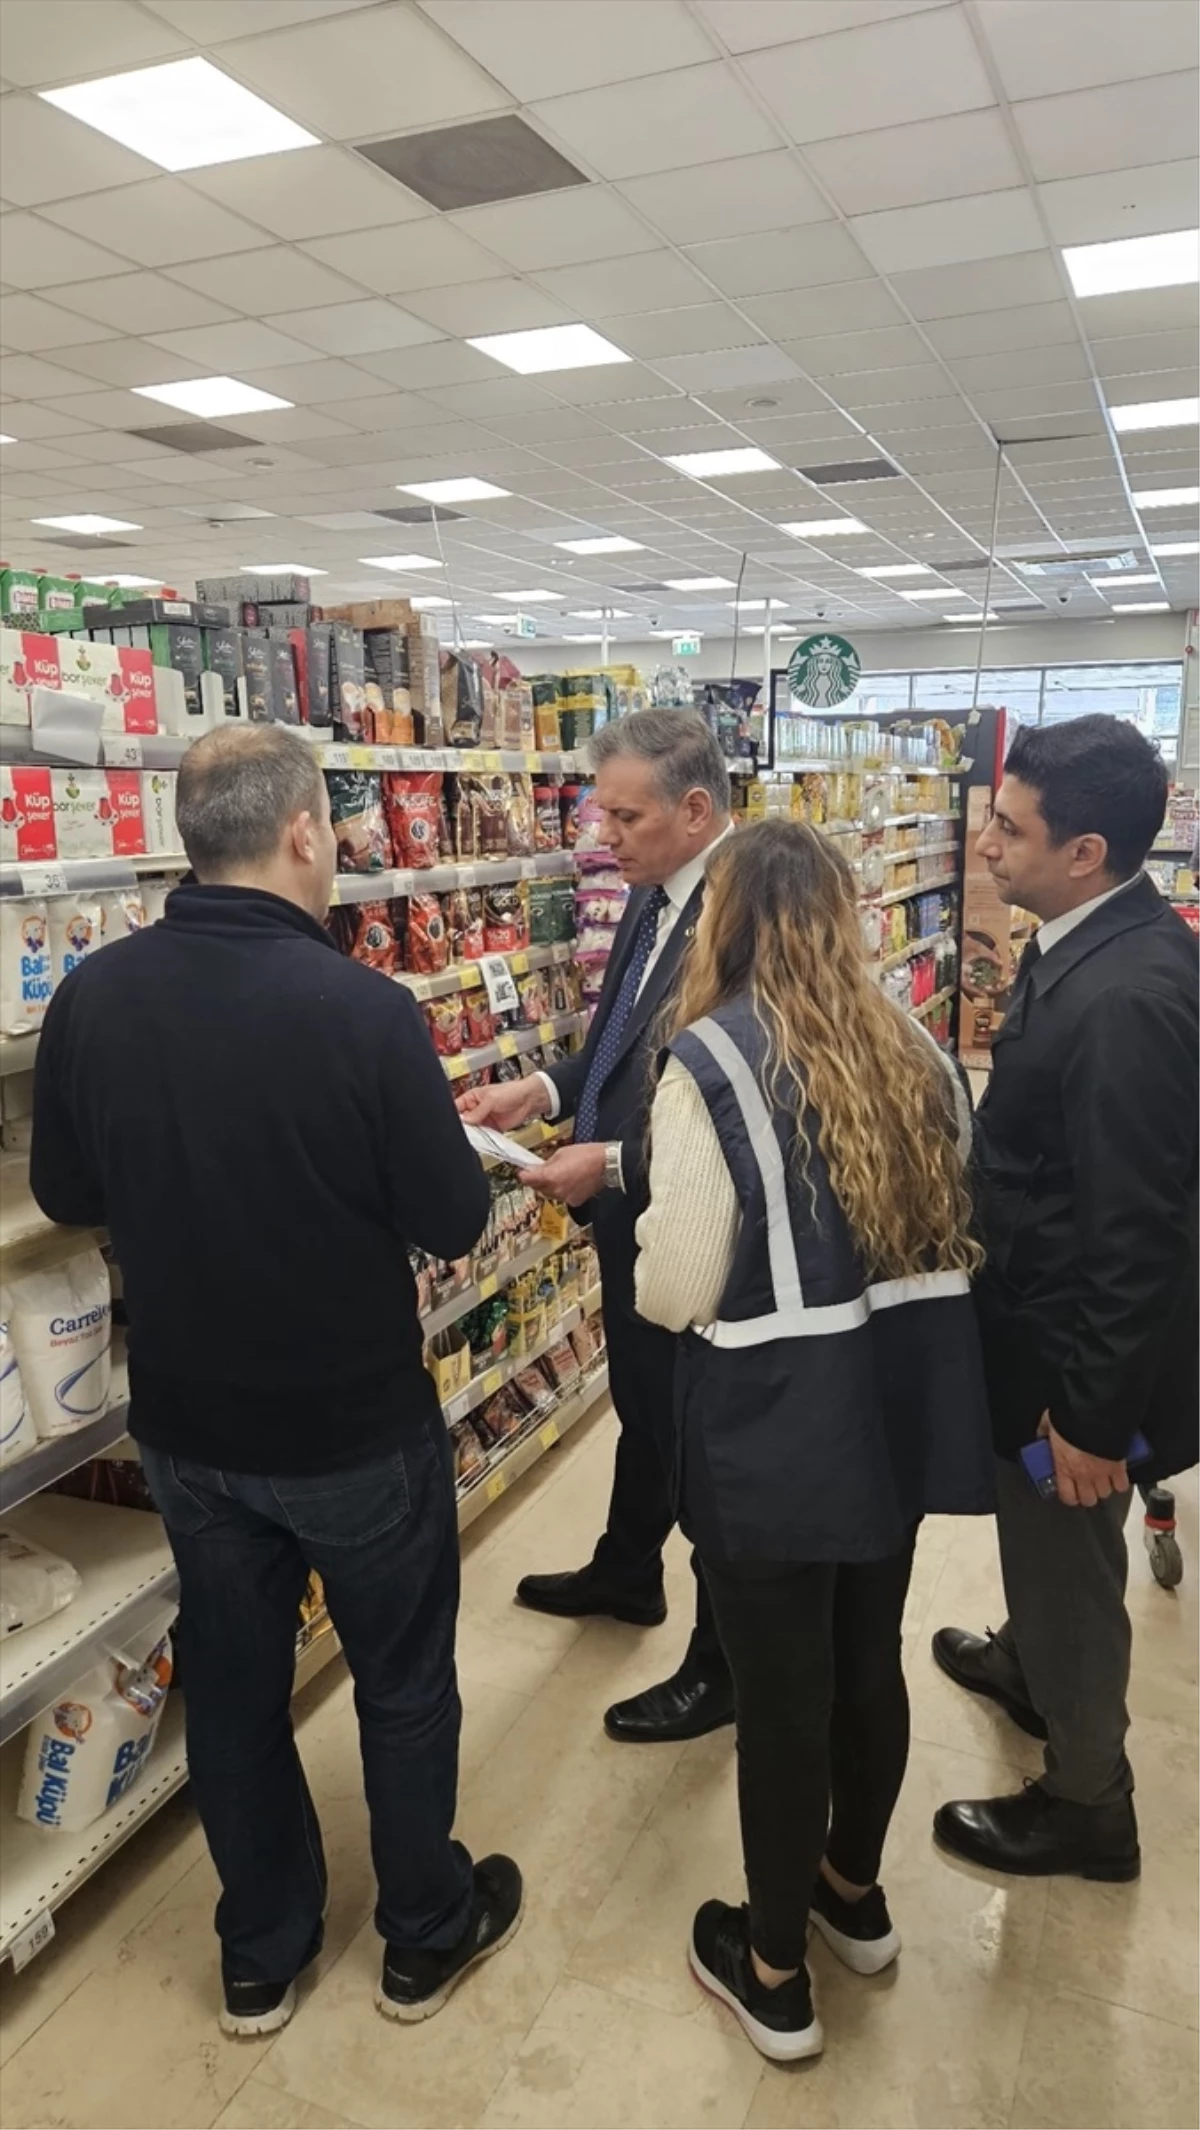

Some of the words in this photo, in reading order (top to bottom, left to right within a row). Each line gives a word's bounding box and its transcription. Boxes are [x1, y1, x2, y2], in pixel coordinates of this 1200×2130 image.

[33, 659, 58, 676] Küp
[129, 671, 152, 687] Küp
[24, 792, 50, 808] Küp
[118, 791, 140, 807] Küp
[21, 955, 43, 977] Bal
[47, 1739, 76, 1774] Bal
[35, 1772, 68, 1826] Küpü
